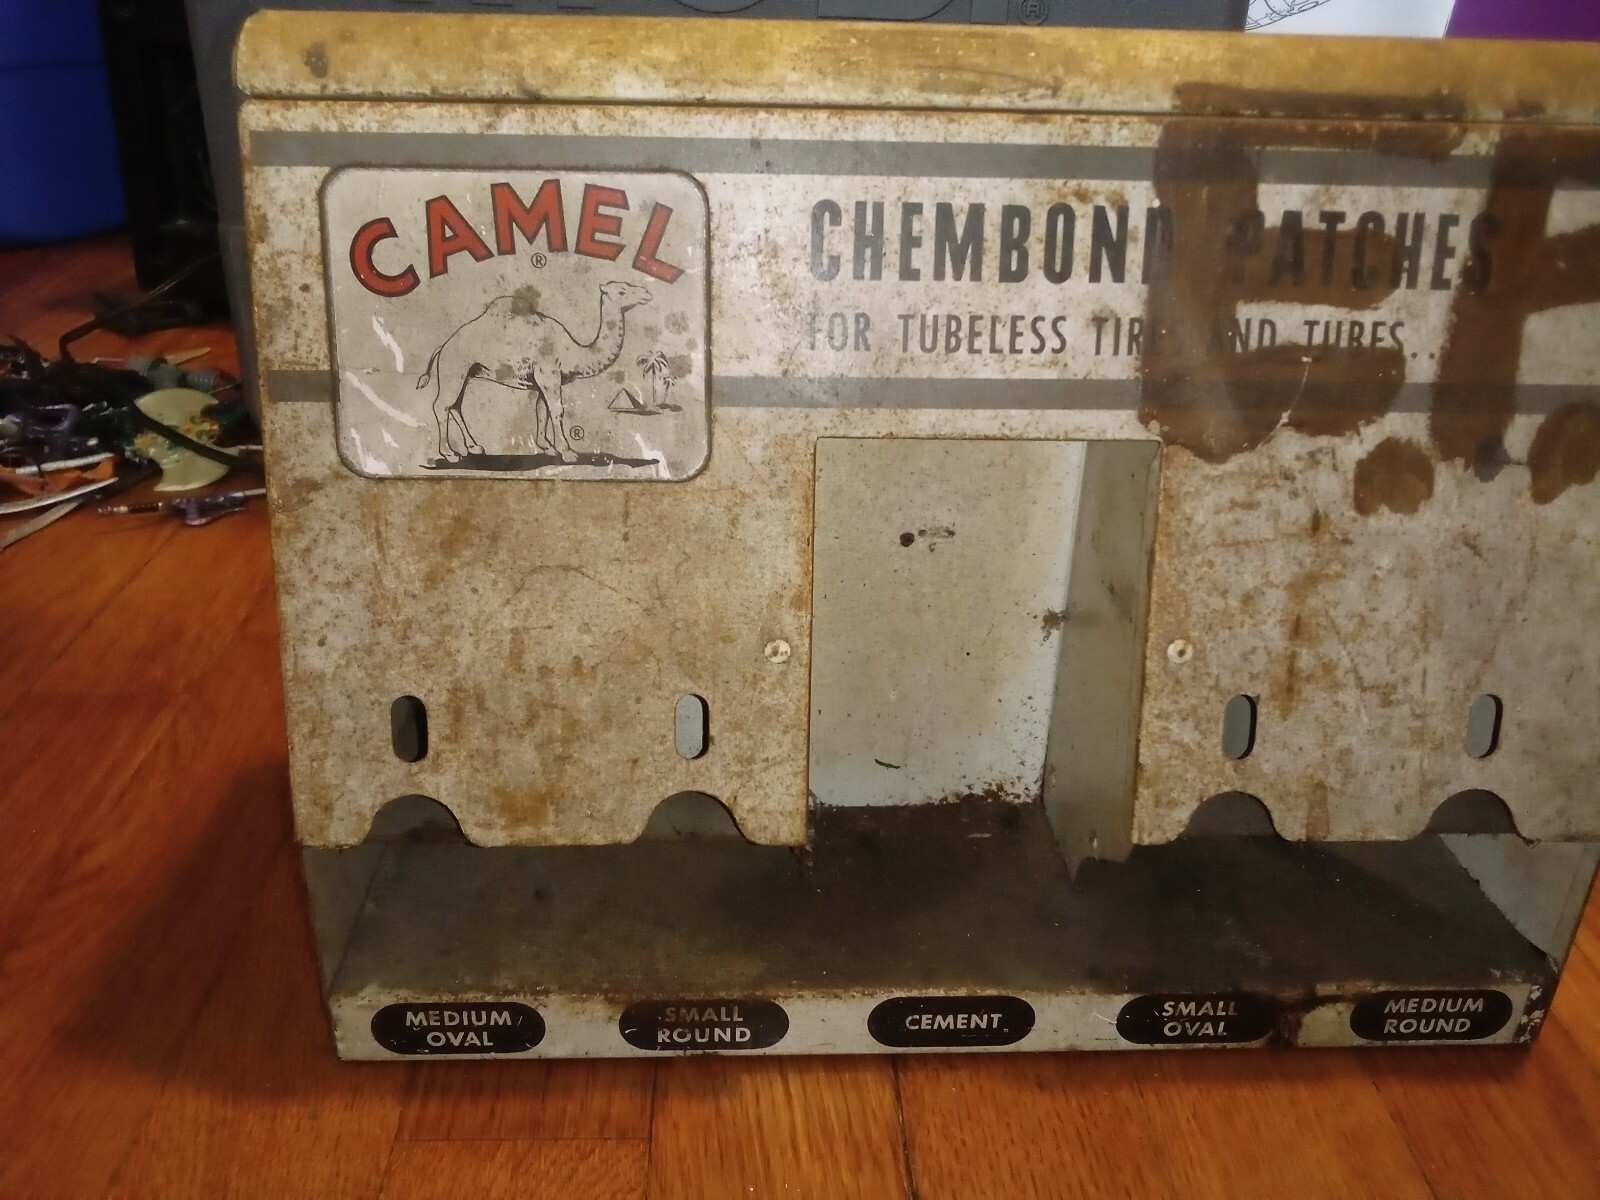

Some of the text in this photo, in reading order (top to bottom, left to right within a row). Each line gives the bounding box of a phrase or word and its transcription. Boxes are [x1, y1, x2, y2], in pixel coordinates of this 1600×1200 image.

[350, 179, 686, 297] CAMEL
[810, 199, 1501, 291] CHEMBOND PATCHES
[808, 311, 871, 352] FOR
[897, 314, 1068, 355] TUBELESS
[1091, 316, 1166, 357] TIR
[1162, 1001, 1239, 1018] SMALL
[1384, 997, 1485, 1014] MEDIUM
[405, 1009, 513, 1027] MEDIUM
[664, 1006, 744, 1024] SMALL
[905, 1012, 1003, 1031] CEMENT
[657, 1026, 753, 1044] ROUND
[1163, 1020, 1229, 1038] OVAL
[1384, 1017, 1472, 1035] ROUND
[426, 1030, 494, 1048] OVAL
